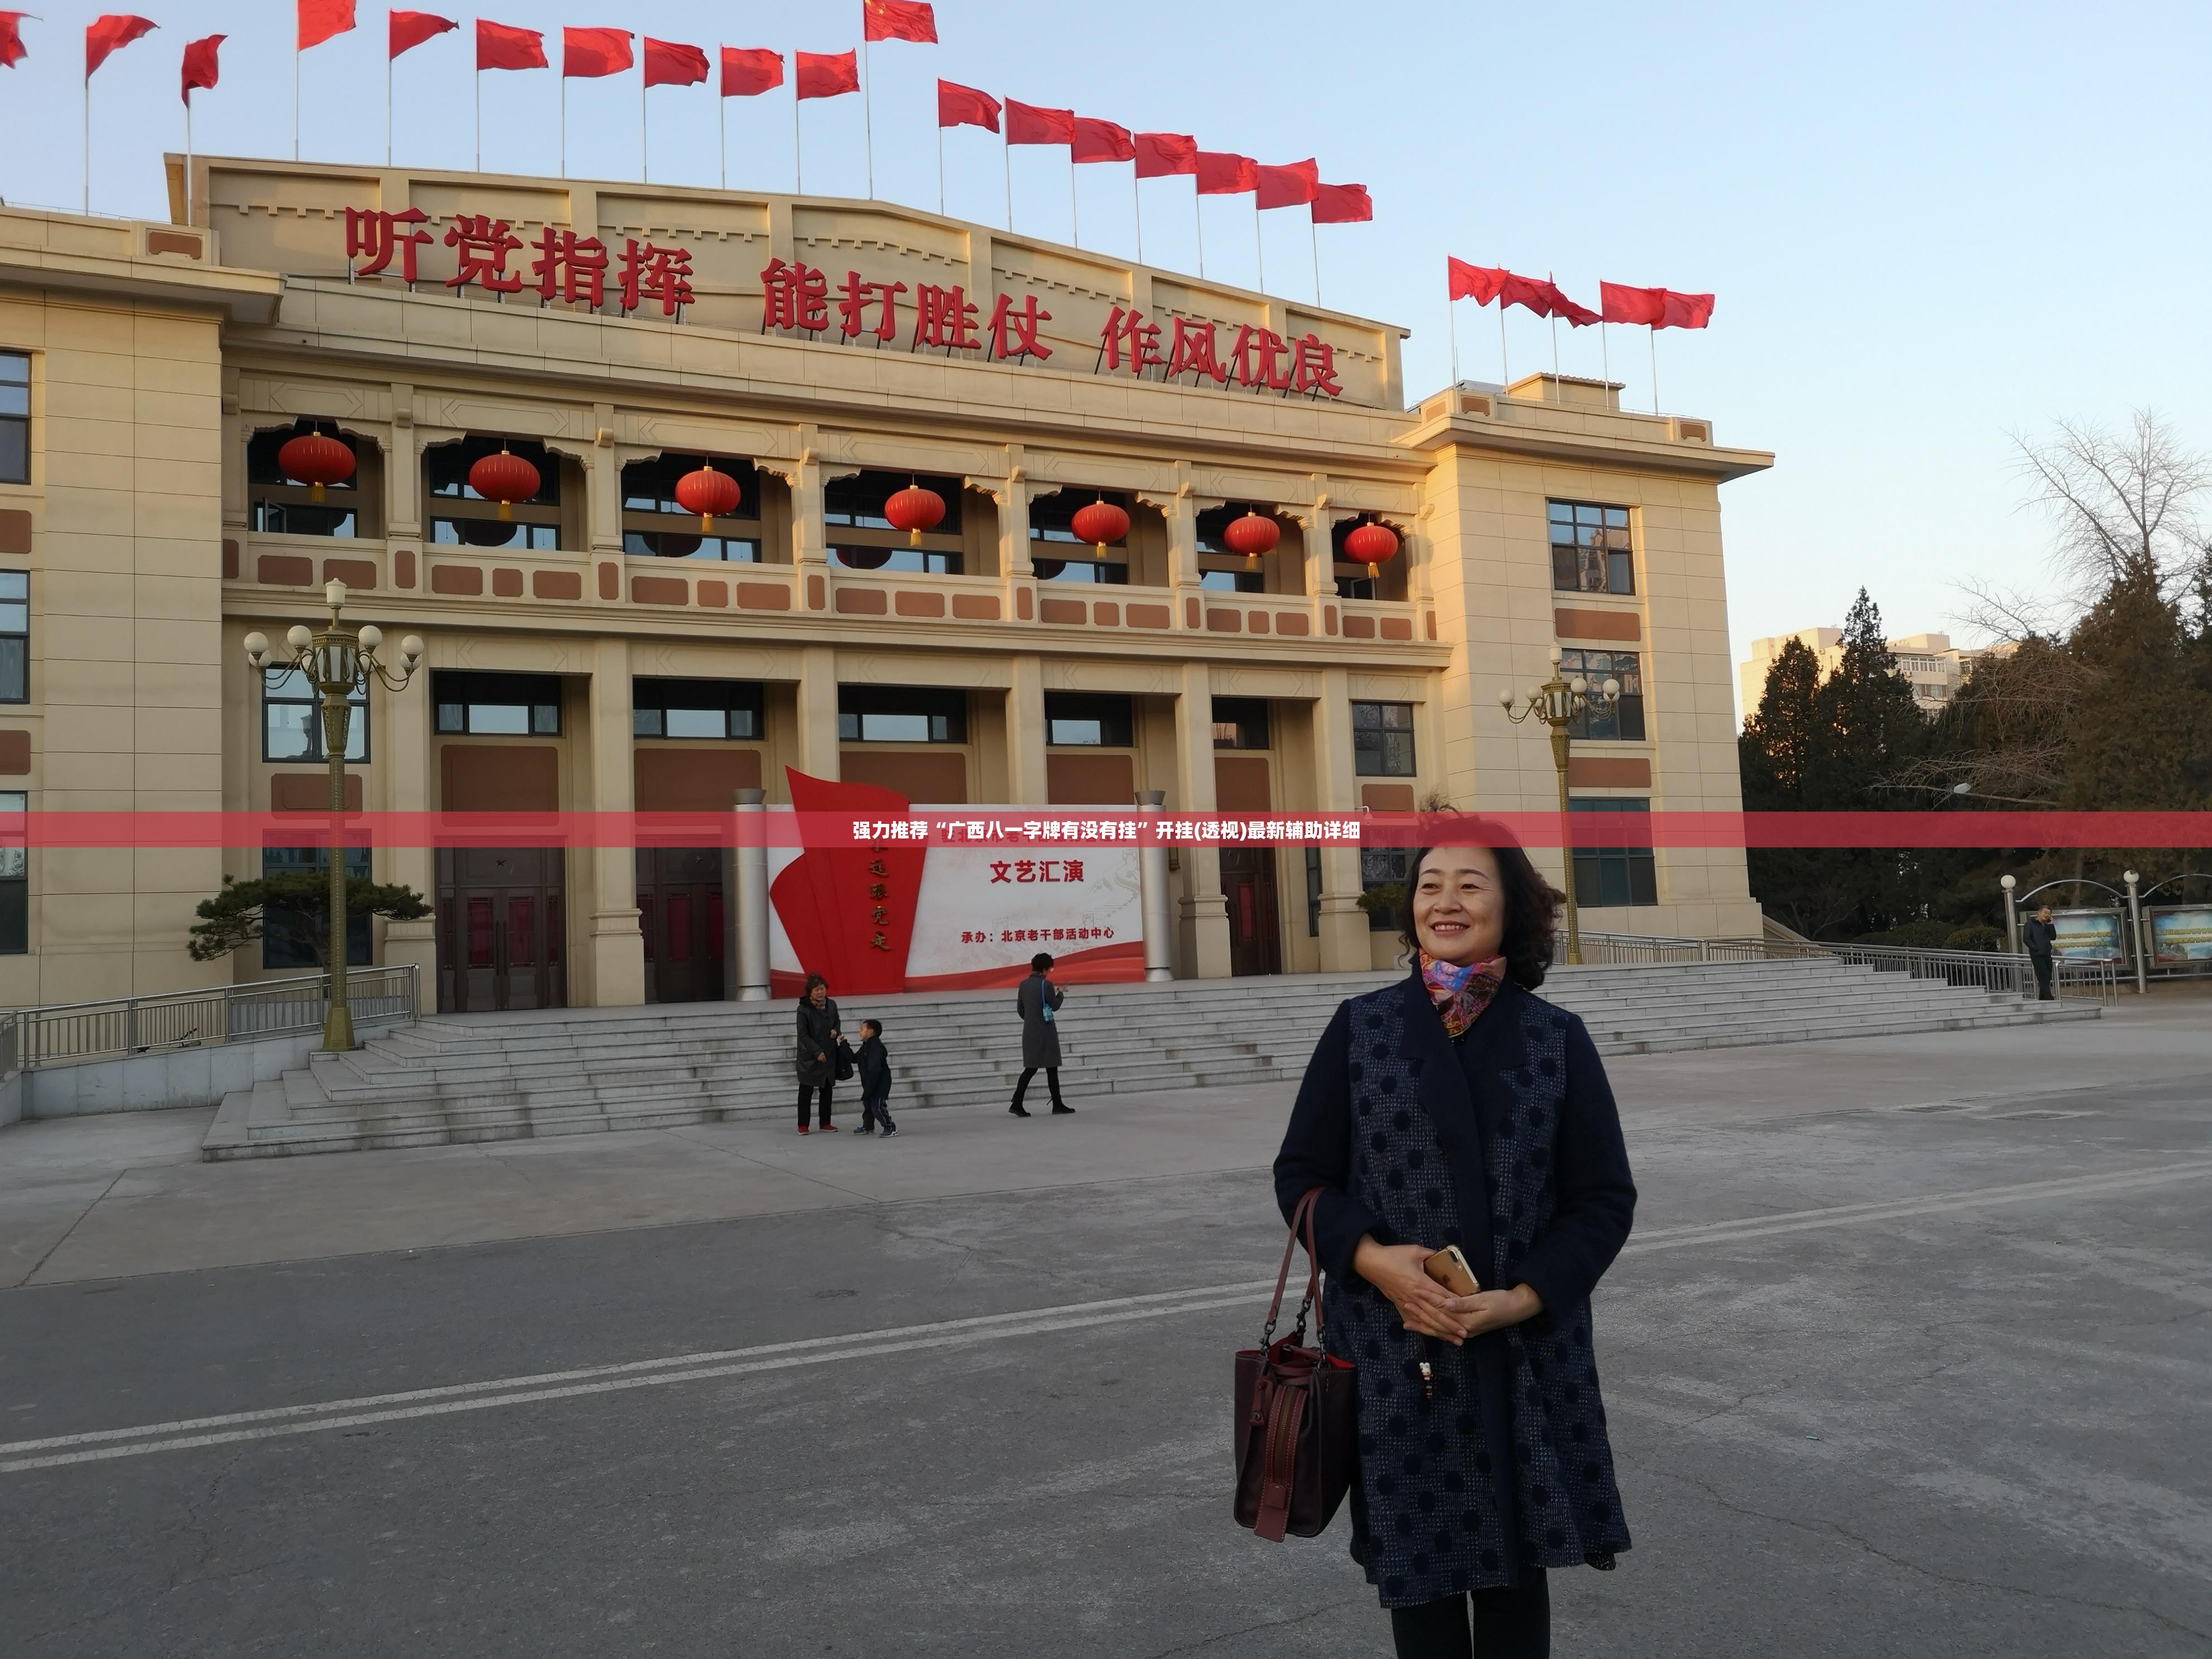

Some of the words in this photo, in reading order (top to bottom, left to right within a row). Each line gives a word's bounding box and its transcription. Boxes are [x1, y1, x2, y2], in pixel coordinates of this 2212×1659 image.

[345, 206, 695, 316] 听党指挥
[760, 258, 1053, 360] 能打胜仗
[1100, 306, 1343, 396] 作风优良
[989, 859, 1084, 884] 文艺汇演
